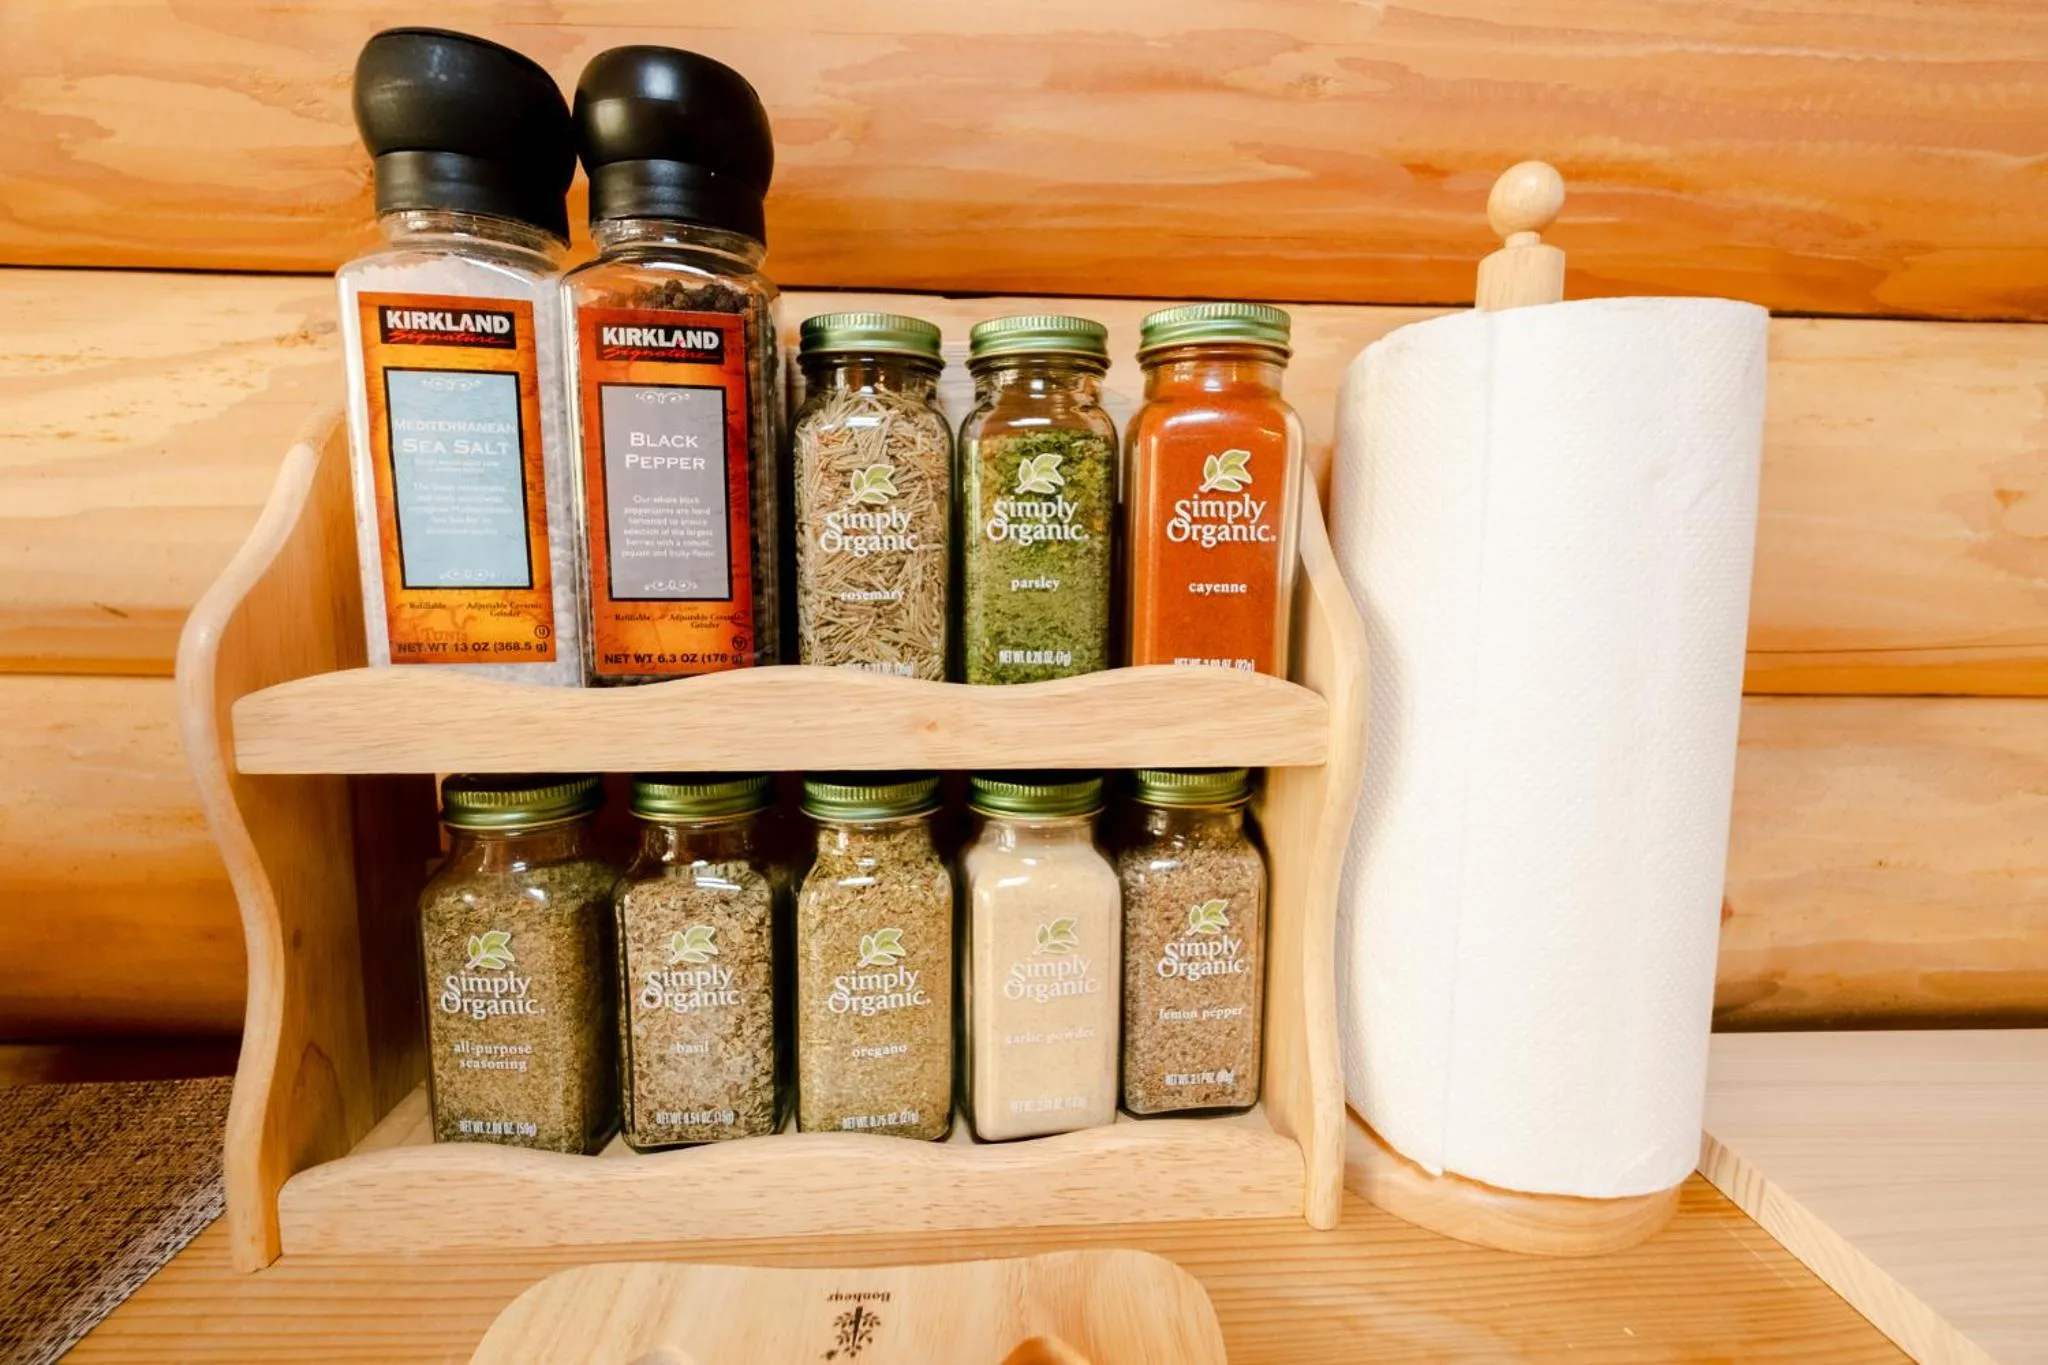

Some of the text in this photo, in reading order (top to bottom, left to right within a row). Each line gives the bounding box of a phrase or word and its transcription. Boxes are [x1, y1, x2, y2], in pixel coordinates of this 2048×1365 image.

[386, 310, 511, 334] KIRKLAND
[387, 329, 511, 345] Signature
[603, 327, 720, 350] KIRKLAND
[603, 346, 720, 361] Signature
[394, 419, 516, 434] MEDITERRANEAN
[402, 438, 510, 455] SEA SALT
[630, 432, 698, 448] BLACK
[625, 454, 705, 470] PEPPER
[994, 495, 1078, 522] Simply
[1175, 494, 1266, 523] Simply
[826, 507, 913, 534] Simply
[1011, 576, 1060, 591] parsley
[1189, 581, 1247, 595] cayenne
[398, 642, 422, 653] NET
[427, 642, 449, 653] WT
[454, 642, 468, 653] 13
[472, 641, 490, 652] OZ
[604, 653, 629, 664] NET
[634, 653, 655, 664] WT
[658, 653, 677, 664] 6.3
[681, 653, 699, 663] OZ
[1165, 935, 1242, 961] Simply
[1011, 954, 1093, 981] Simply
[446, 971, 532, 998] Simply
[648, 964, 734, 991] Simply
[835, 965, 920, 993] Simply
[1159, 1006, 1243, 1020] lemon pepper
[852, 1043, 908, 1059] oregano
[459, 1058, 528, 1072] seasoning
